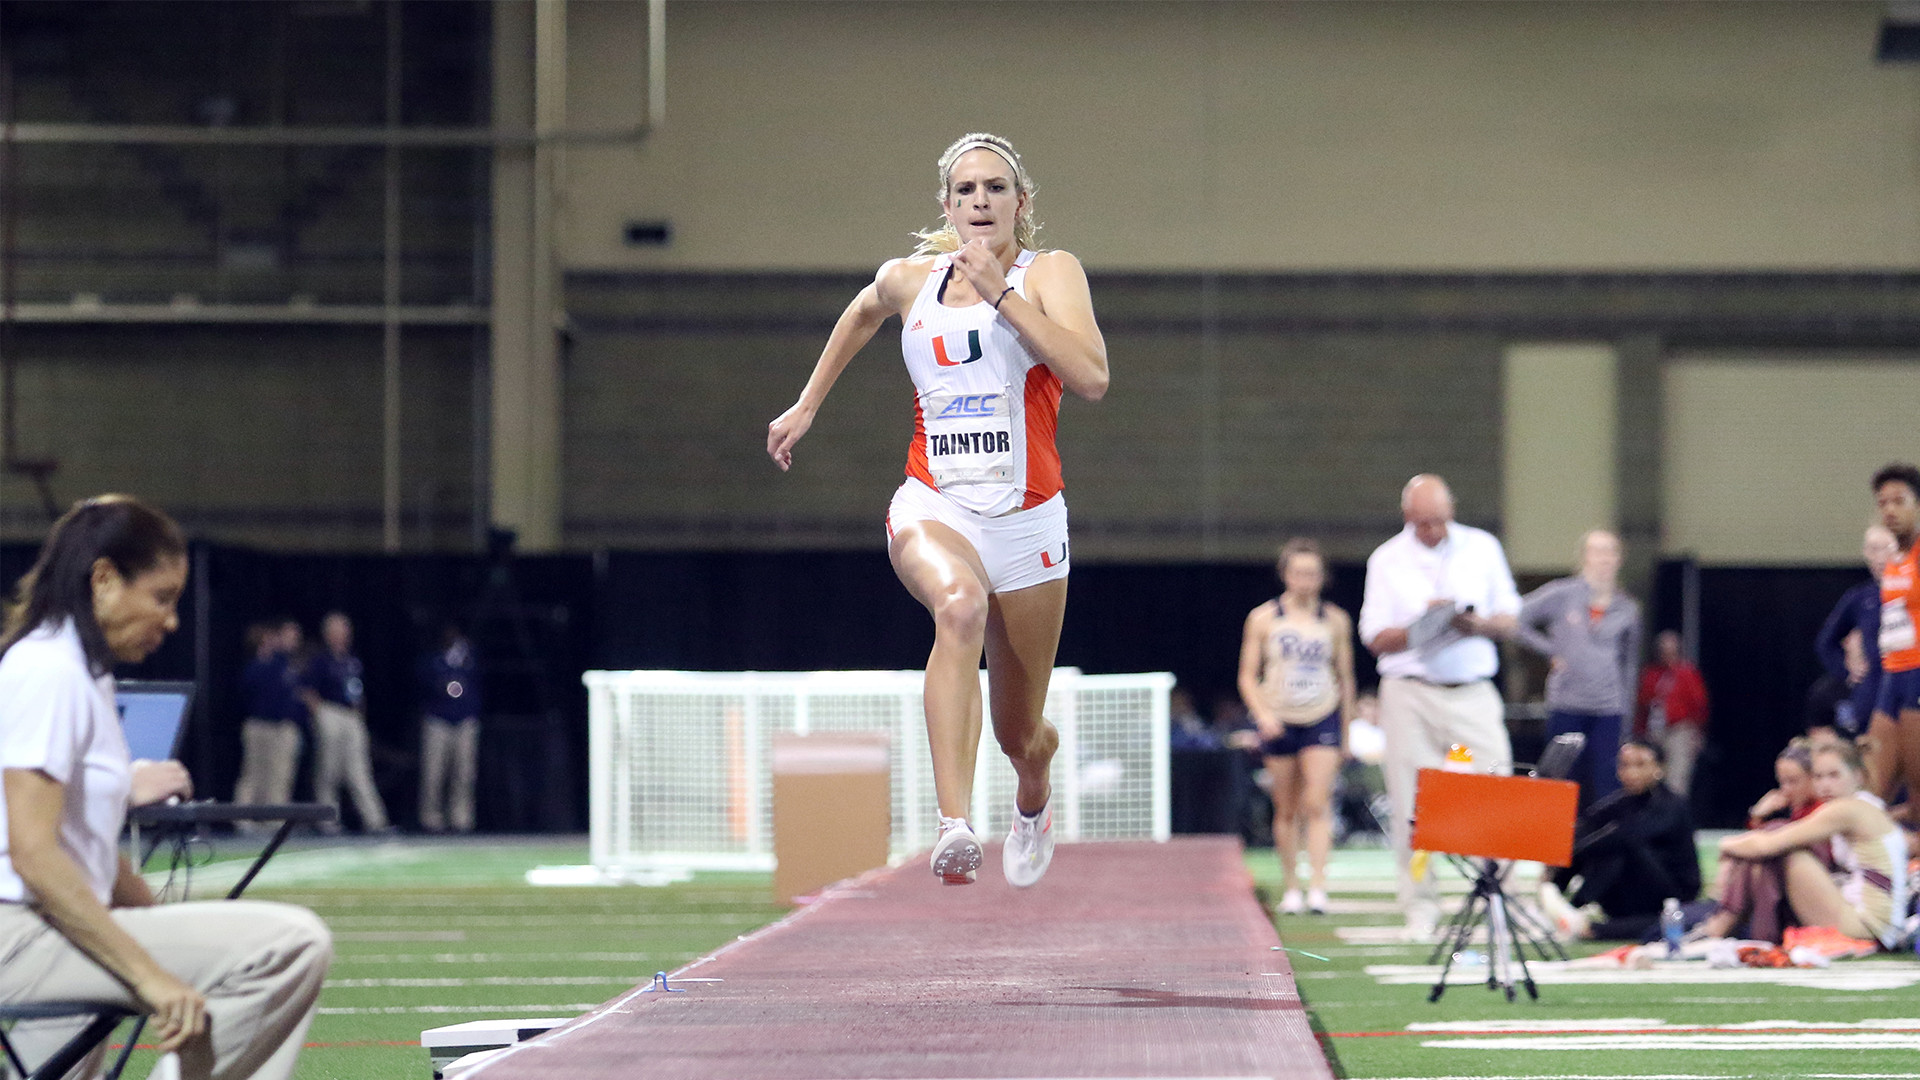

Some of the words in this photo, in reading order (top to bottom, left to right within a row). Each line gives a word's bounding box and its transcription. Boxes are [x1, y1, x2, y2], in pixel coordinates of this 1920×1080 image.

[931, 329, 983, 367] U
[940, 395, 999, 415] ACC
[930, 431, 1010, 457] TAINTOR
[1040, 542, 1067, 568] U
